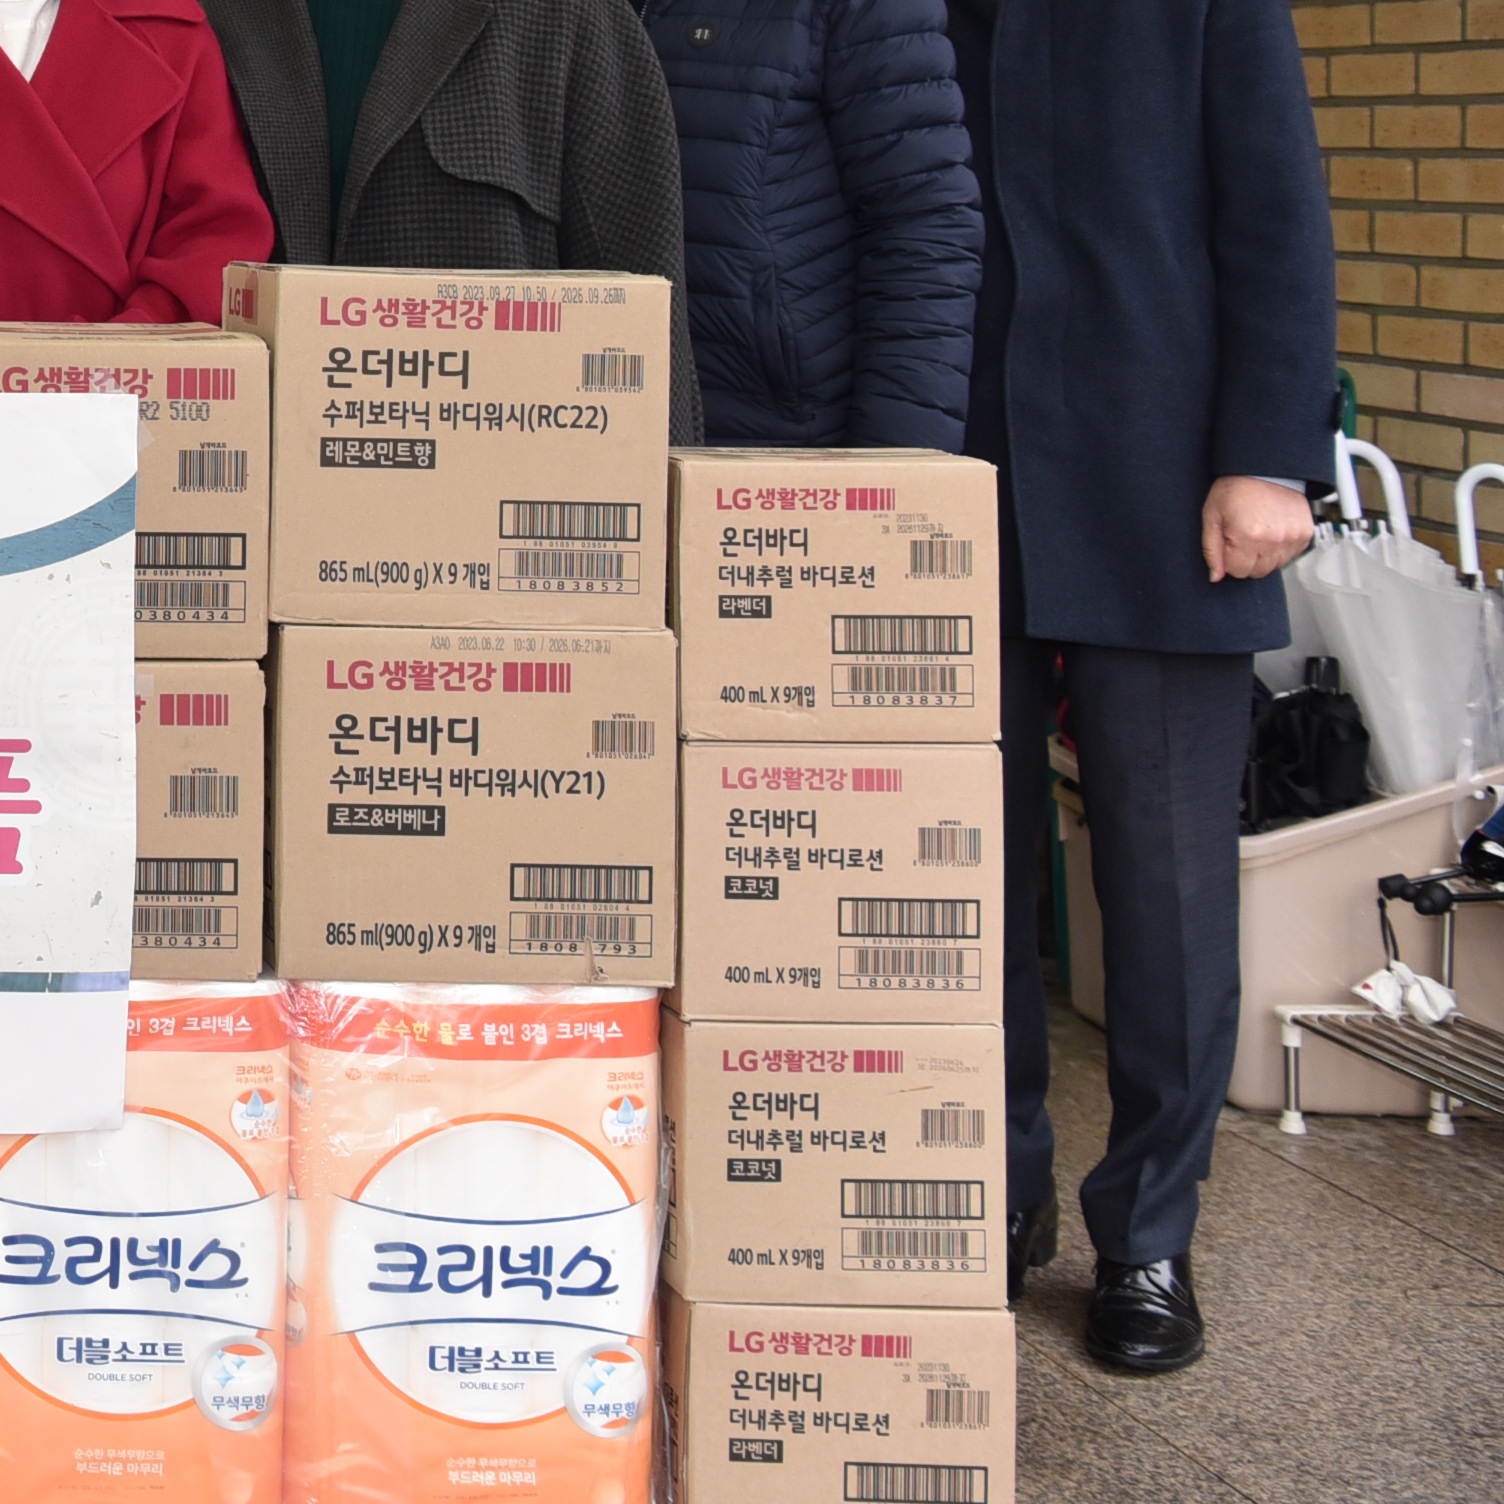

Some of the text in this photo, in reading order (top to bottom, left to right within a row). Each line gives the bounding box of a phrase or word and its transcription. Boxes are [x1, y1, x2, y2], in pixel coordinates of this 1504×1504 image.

[319, 297, 488, 333] LG 생활건강
[321, 347, 470, 391] 온더바디
[322, 401, 609, 435] 수퍼보타닉 바디워시(RC22)
[325, 441, 432, 467] 레몬&민트향
[716, 488, 841, 511] LG 생활건강
[720, 527, 809, 557] 온더바디
[318, 559, 490, 592] 865 mL(900 g) X 9 개입
[516, 580, 623, 591] 18083852
[719, 566, 876, 588] 더내추럴 바디로션
[722, 598, 766, 615] 라벤더
[326, 661, 497, 692] LG 생활건강
[720, 686, 815, 708] 400 mL X 9개입
[850, 695, 957, 705] 18083837
[328, 713, 480, 756] 온더바디
[329, 767, 605, 799] 수퍼보타닉 바디워시(Y21)
[722, 767, 848, 791] LG 생활건강
[333, 808, 441, 830] 로즈&버베나
[725, 808, 817, 838] 온더바디
[725, 847, 884, 871] 더내추럴 바디로션
[728, 878, 774, 897] 코코넛
[724, 967, 821, 988] 400 mL X 9개입
[856, 978, 964, 988] 18083836
[149, 1015, 253, 1038] 3겹 크리넥스
[723, 1049, 849, 1073] LG 생활건강
[728, 1092, 820, 1121] 온더바디
[728, 1130, 887, 1153] 더내추럴 바디로션
[731, 1161, 777, 1178] 코코넛
[368, 1242, 620, 1301] 크리넥스
[728, 1249, 825, 1270] 400 mL X 9개입
[56, 1337, 186, 1365] 더블소프트
[729, 1330, 856, 1356] LG 생활건강
[428, 1344, 557, 1373] 더블소프트
[88, 1372, 153, 1382] DOUBLE SOFT
[460, 1381, 525, 1391] DOUBLE SOFT
[731, 1370, 823, 1402] 온더바디
[730, 1408, 890, 1436] 더내추럴 바디로션
[732, 1442, 778, 1460] 라벤더
